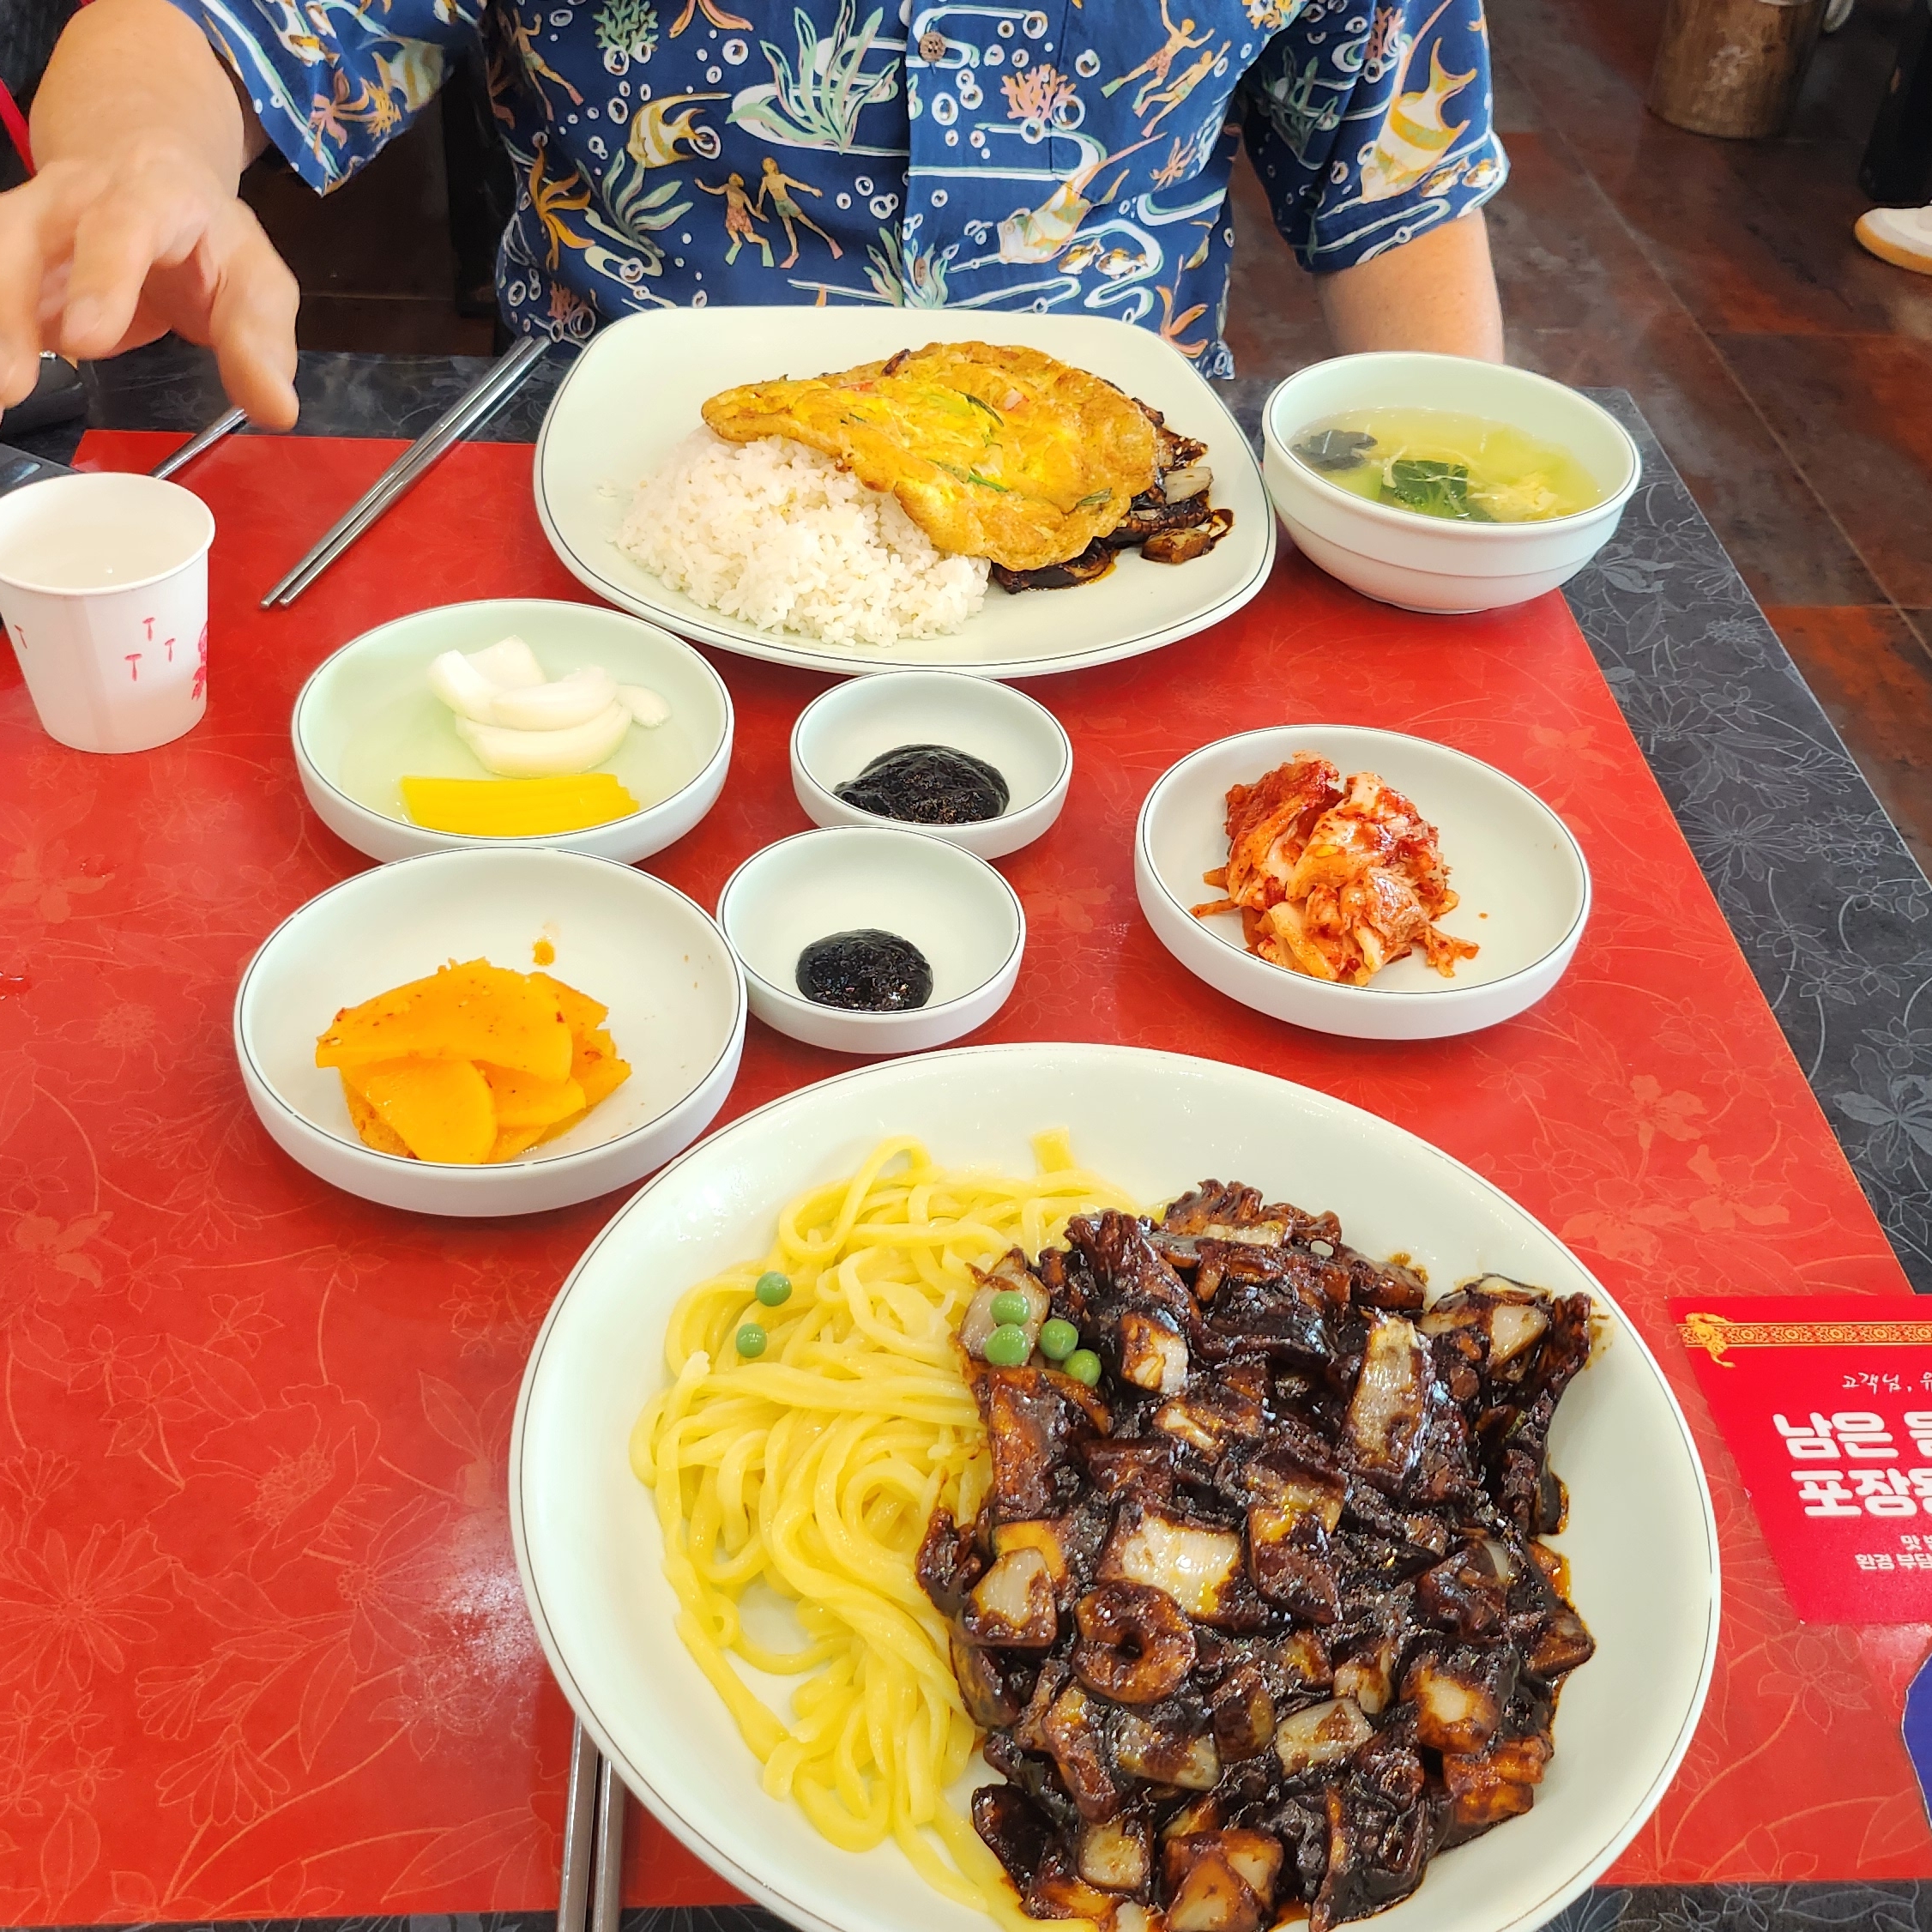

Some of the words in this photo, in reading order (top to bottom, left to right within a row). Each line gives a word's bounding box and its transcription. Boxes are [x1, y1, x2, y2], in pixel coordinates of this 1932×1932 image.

[1841, 1372, 1912, 1396] 고객님,
[1772, 1411, 1900, 1458] 남은
[1900, 1534, 1923, 1551] 맛
[1854, 1553, 1895, 1571] 환경
